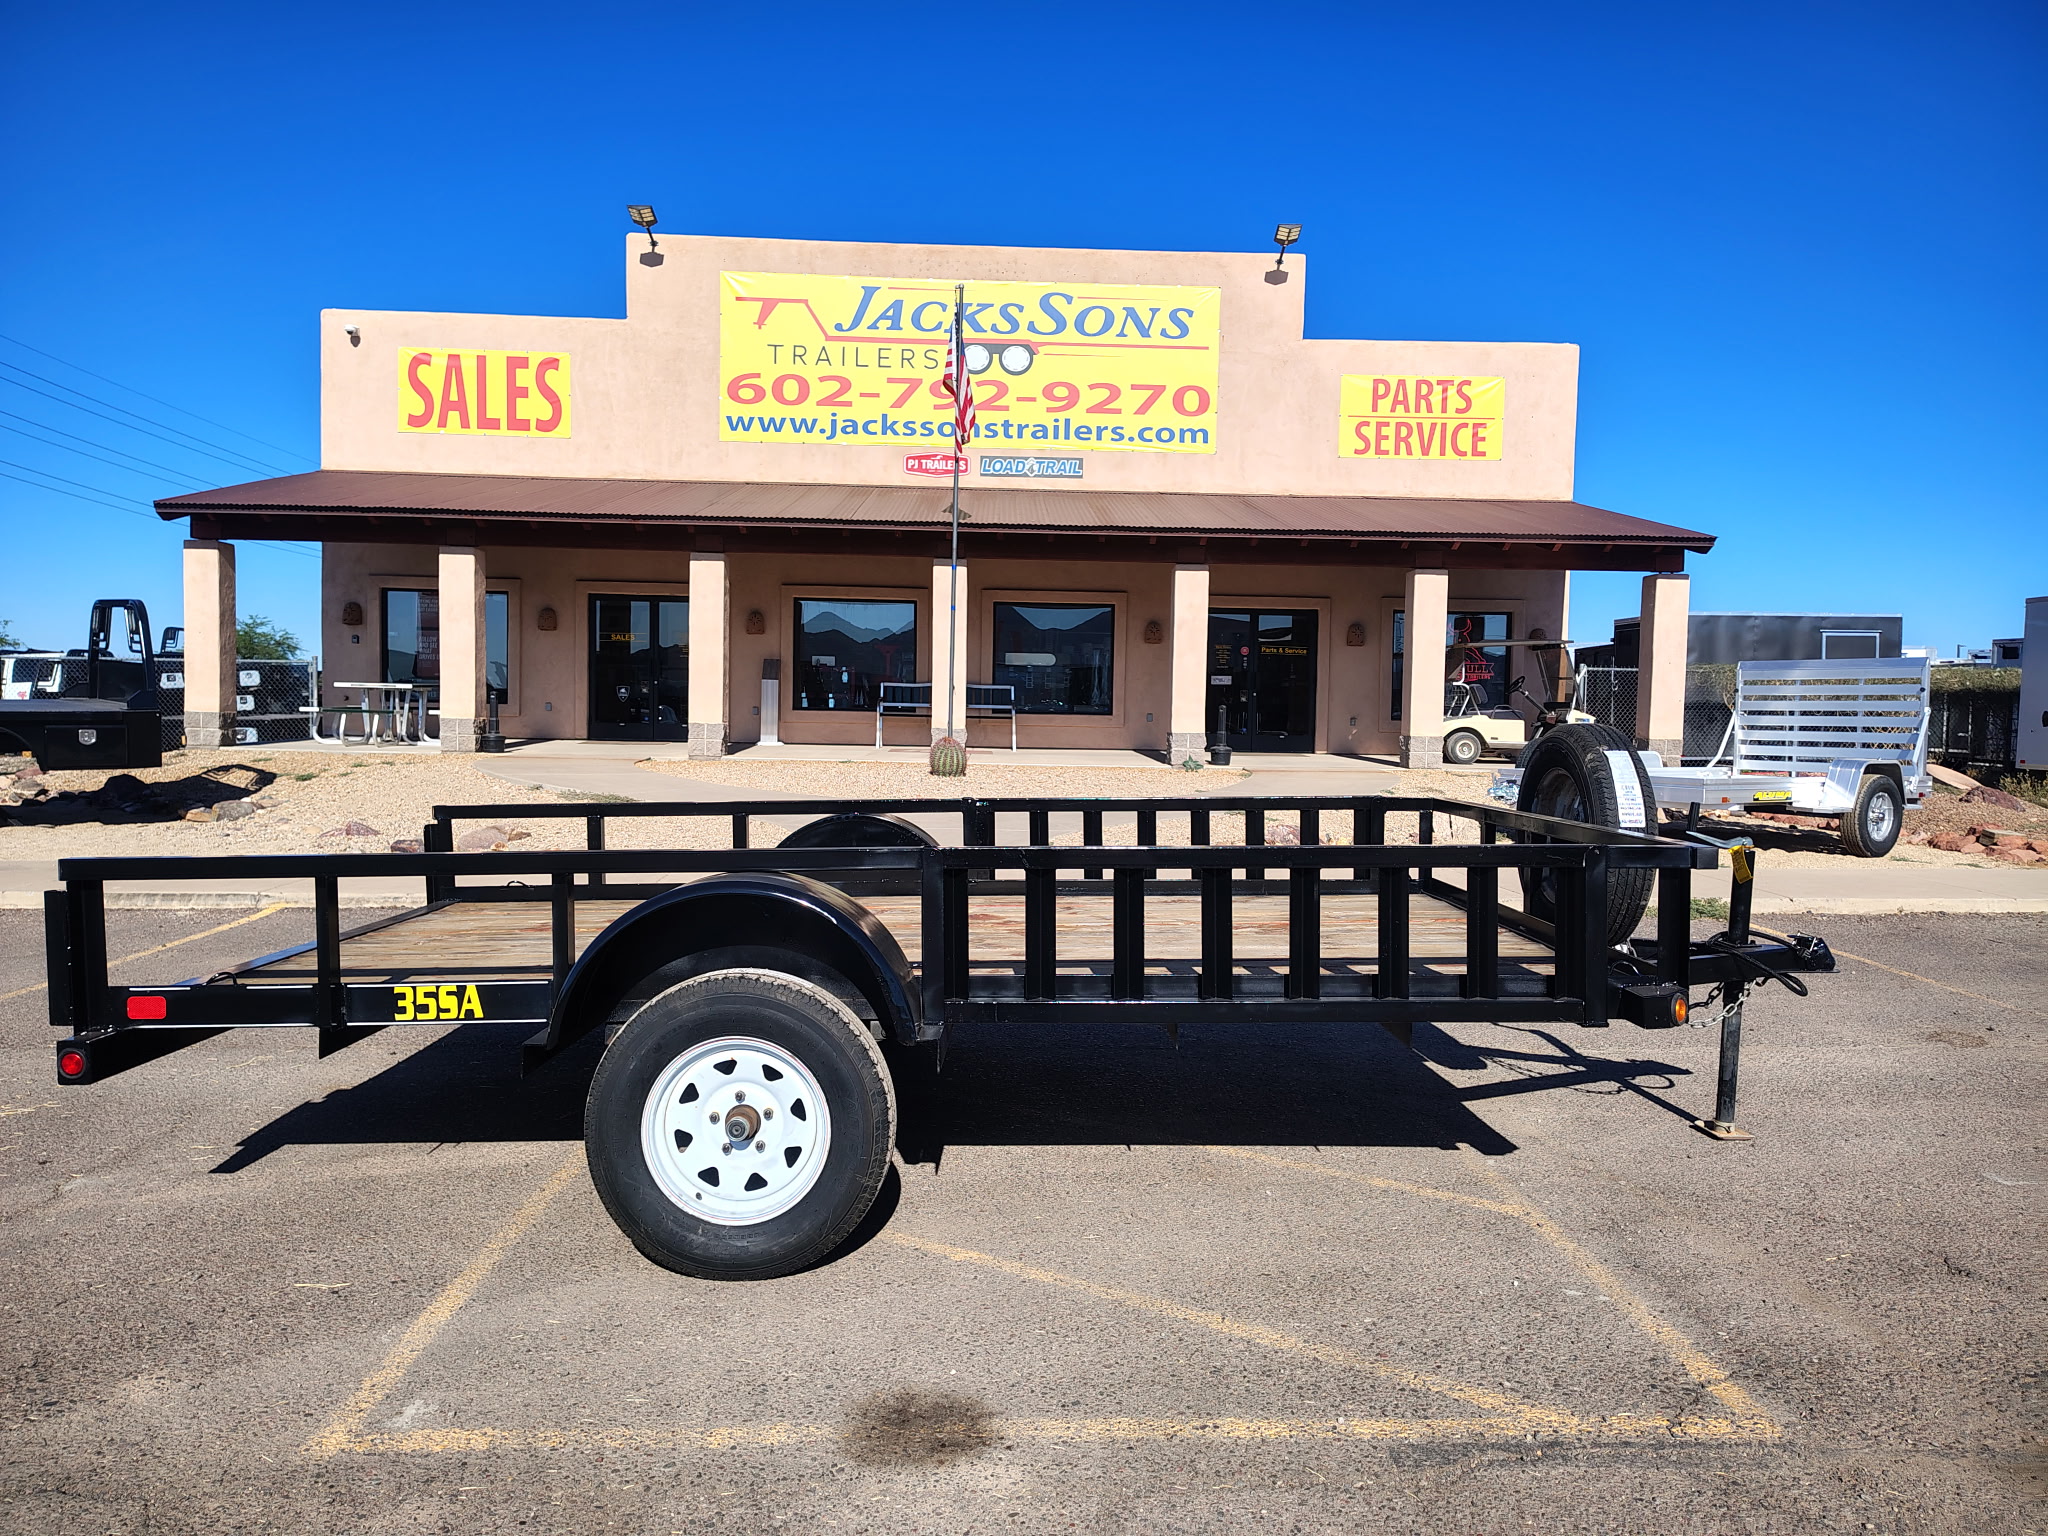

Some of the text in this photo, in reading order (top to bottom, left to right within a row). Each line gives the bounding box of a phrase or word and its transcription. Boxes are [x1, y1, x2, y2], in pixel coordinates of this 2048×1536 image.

[767, 344, 939, 370] TRAILERS
[407, 352, 562, 433] SALES
[726, 373, 1210, 417] 602-792-9270
[1371, 378, 1473, 414] PARTS
[1353, 420, 1488, 457] SERVICE
[907, 459, 919, 469] PJ
[982, 459, 1082, 474] LOAD TRAIL
[1753, 791, 1792, 801] ALUMA
